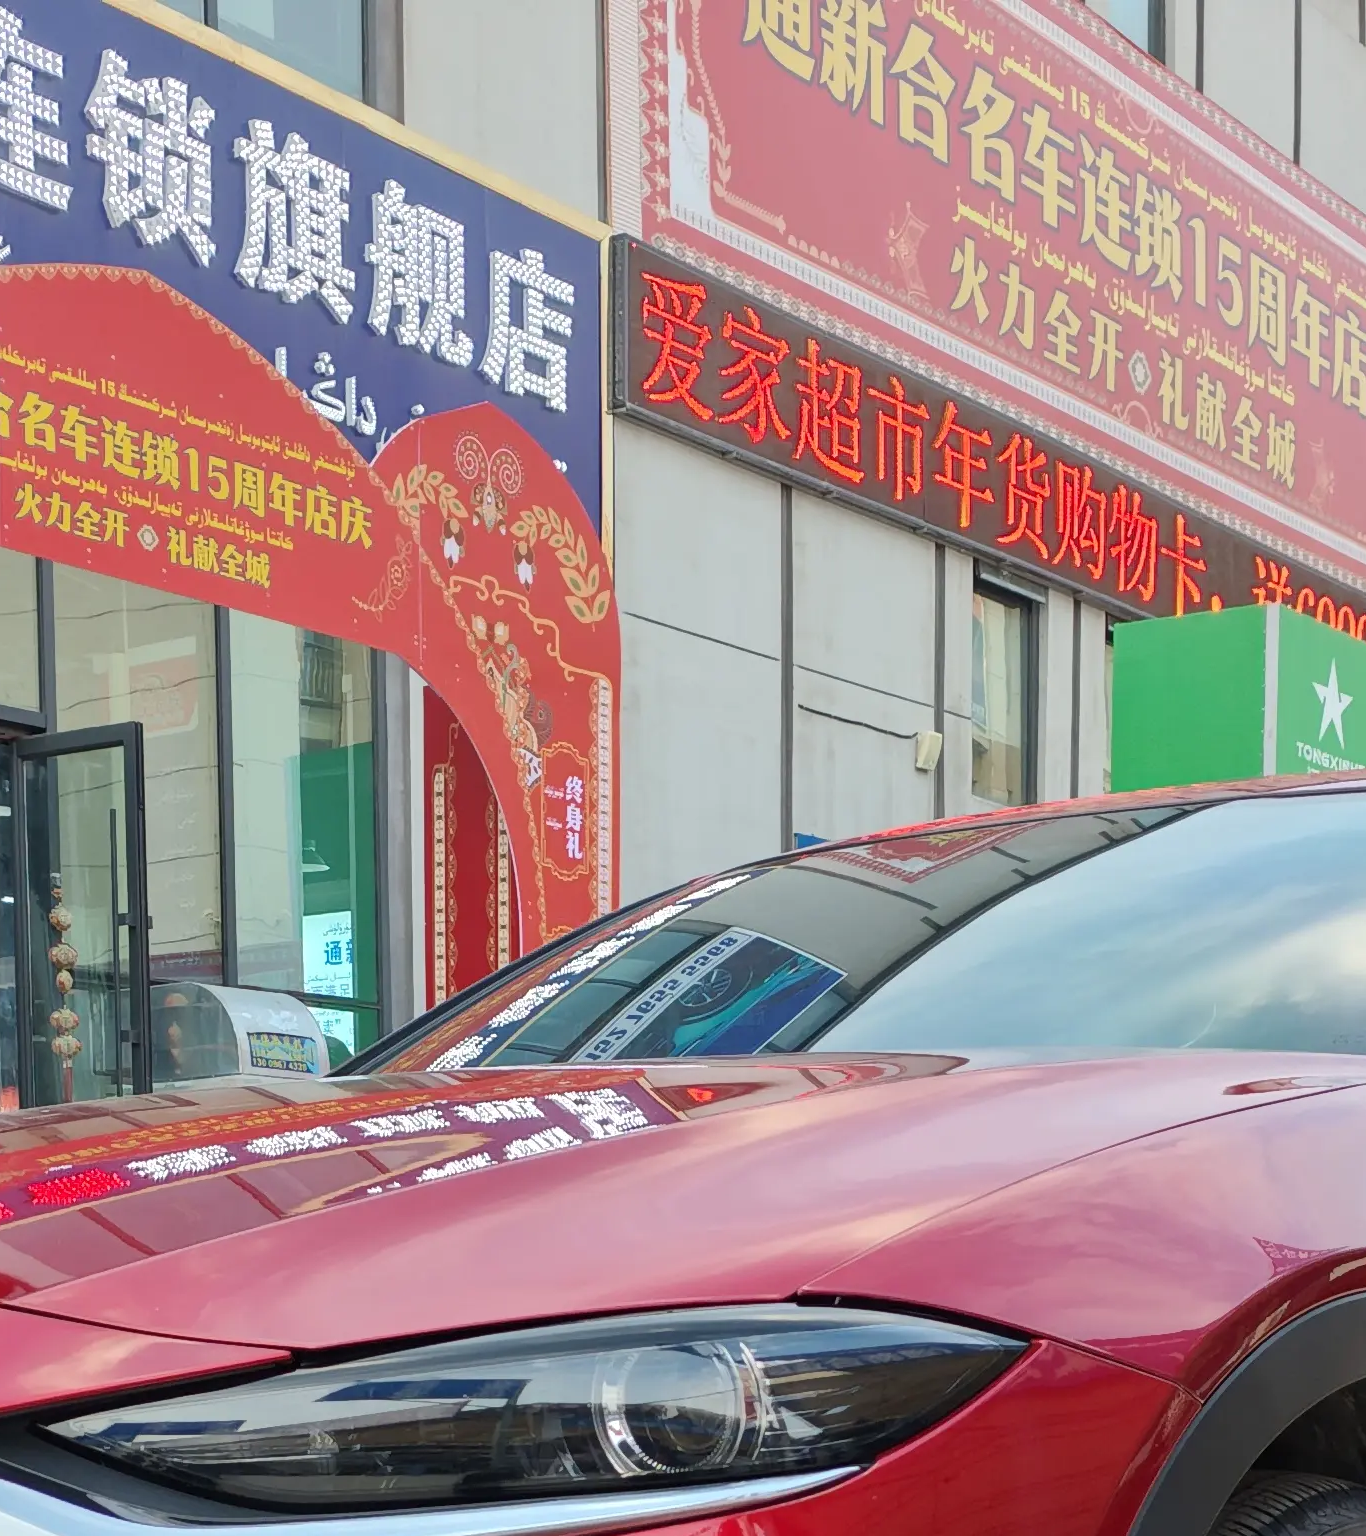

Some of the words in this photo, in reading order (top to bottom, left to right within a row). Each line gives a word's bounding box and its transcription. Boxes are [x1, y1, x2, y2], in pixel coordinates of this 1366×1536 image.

[1070, 85, 1090, 120] 15
[100, 378, 115, 398] 15
[950, 235, 1124, 393] 火力全开
[1157, 348, 1296, 490] 礼献全城
[14, 482, 130, 547] 火力全开
[167, 525, 271, 589] 礼献全城
[566, 776, 583, 859] 终身礼
